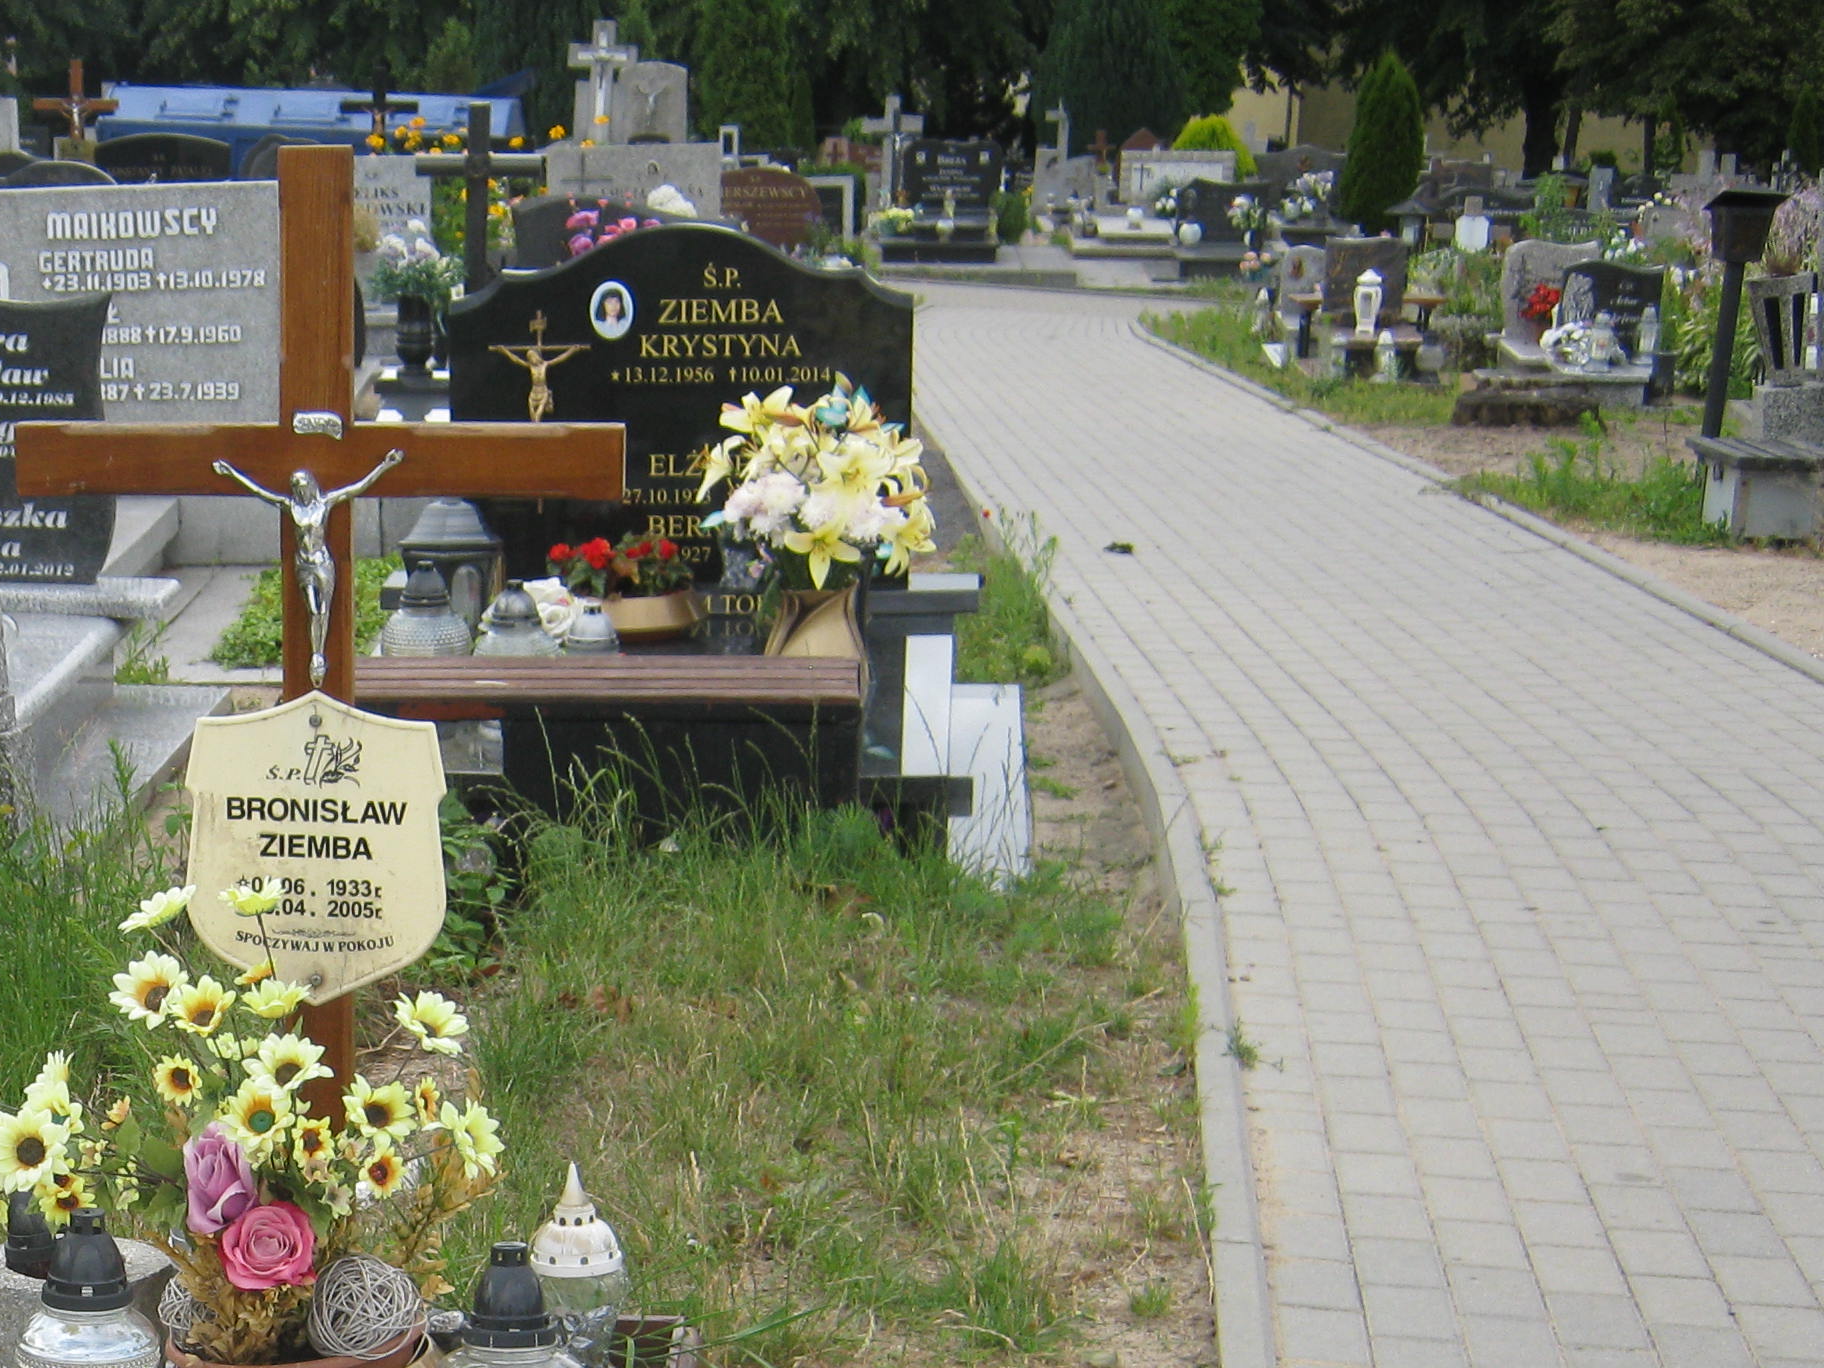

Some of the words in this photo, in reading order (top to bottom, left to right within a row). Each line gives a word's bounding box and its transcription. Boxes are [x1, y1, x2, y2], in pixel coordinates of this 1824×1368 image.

[38, 247, 155, 274] GERTRUDA
[168, 268, 266, 290] 13.10.1978
[702, 261, 743, 289] Ś.P.
[657, 298, 785, 324] ZIEMBA
[158, 324, 242, 345] 17.9.1960
[639, 333, 803, 358] KRYSTYNA
[625, 366, 716, 383] 13.12.1956
[740, 366, 832, 383] 10.01.2014
[149, 381, 240, 401] 23.7.1939
[265, 764, 302, 781] Ś.P.
[225, 796, 409, 826] BRONISŁAW
[258, 832, 375, 861] ZIEMBA
[235, 929, 319, 953] SPOCZYWAJ
[322, 941, 335, 953] W
[338, 935, 395, 953] POKOJU
